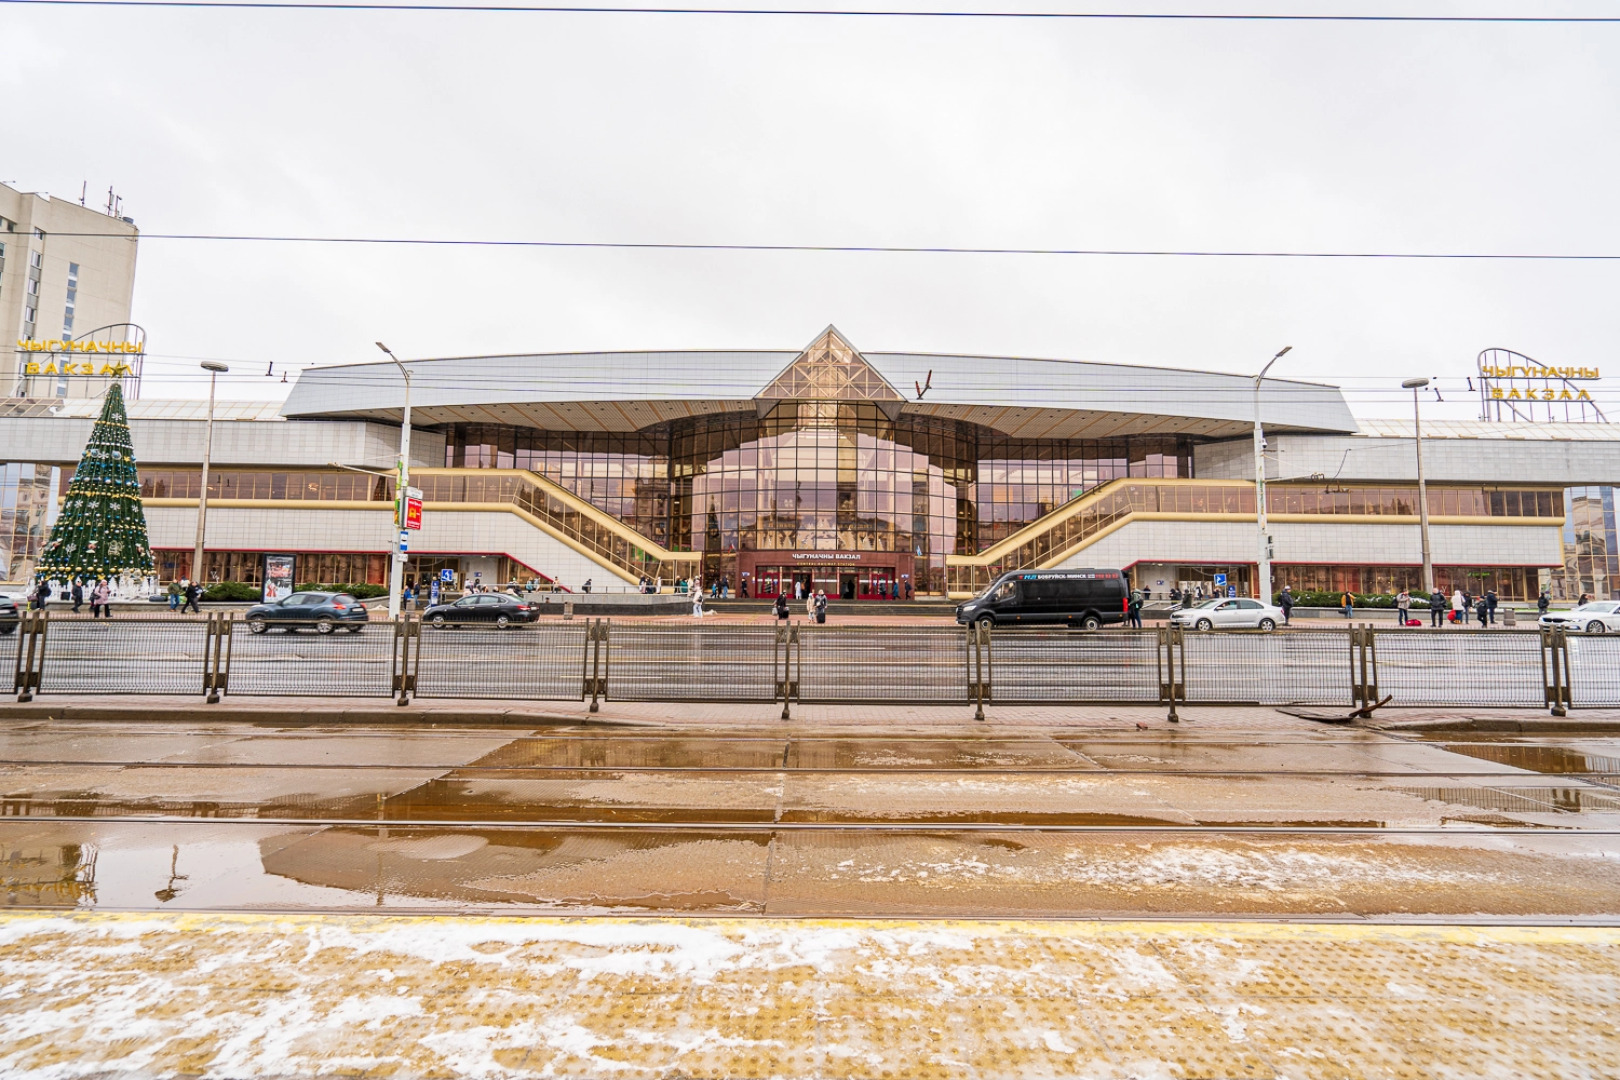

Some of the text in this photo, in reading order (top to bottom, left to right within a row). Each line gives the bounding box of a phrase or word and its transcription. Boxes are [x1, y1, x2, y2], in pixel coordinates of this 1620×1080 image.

[17, 340, 142, 352] ЧЫГУНАЧНЫ
[1482, 366, 1599, 377] ЧЫГУНАЧНЫ
[1491, 388, 1591, 400] ВАКЗАЛ
